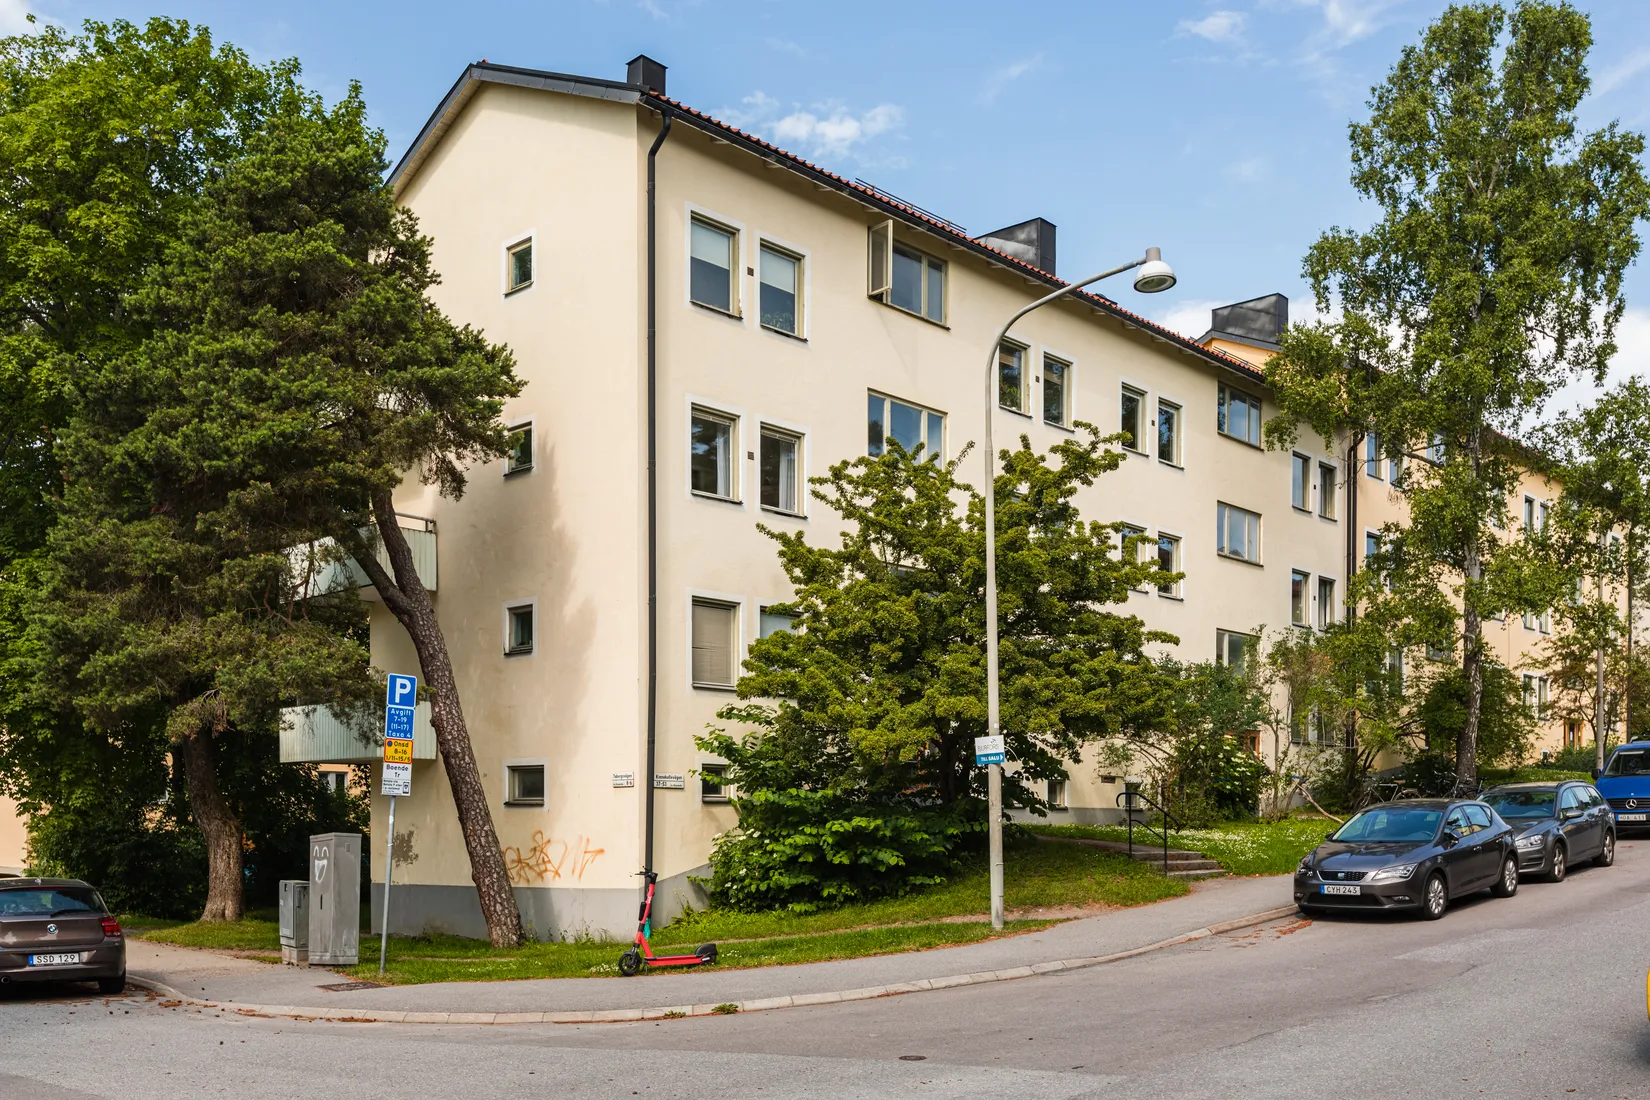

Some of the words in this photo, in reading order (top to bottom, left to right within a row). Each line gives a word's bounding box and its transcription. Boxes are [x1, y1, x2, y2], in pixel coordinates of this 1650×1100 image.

[395, 678, 411, 703] P
[391, 722, 409, 730] (11-17)
[37, 955, 54, 963] SSD
